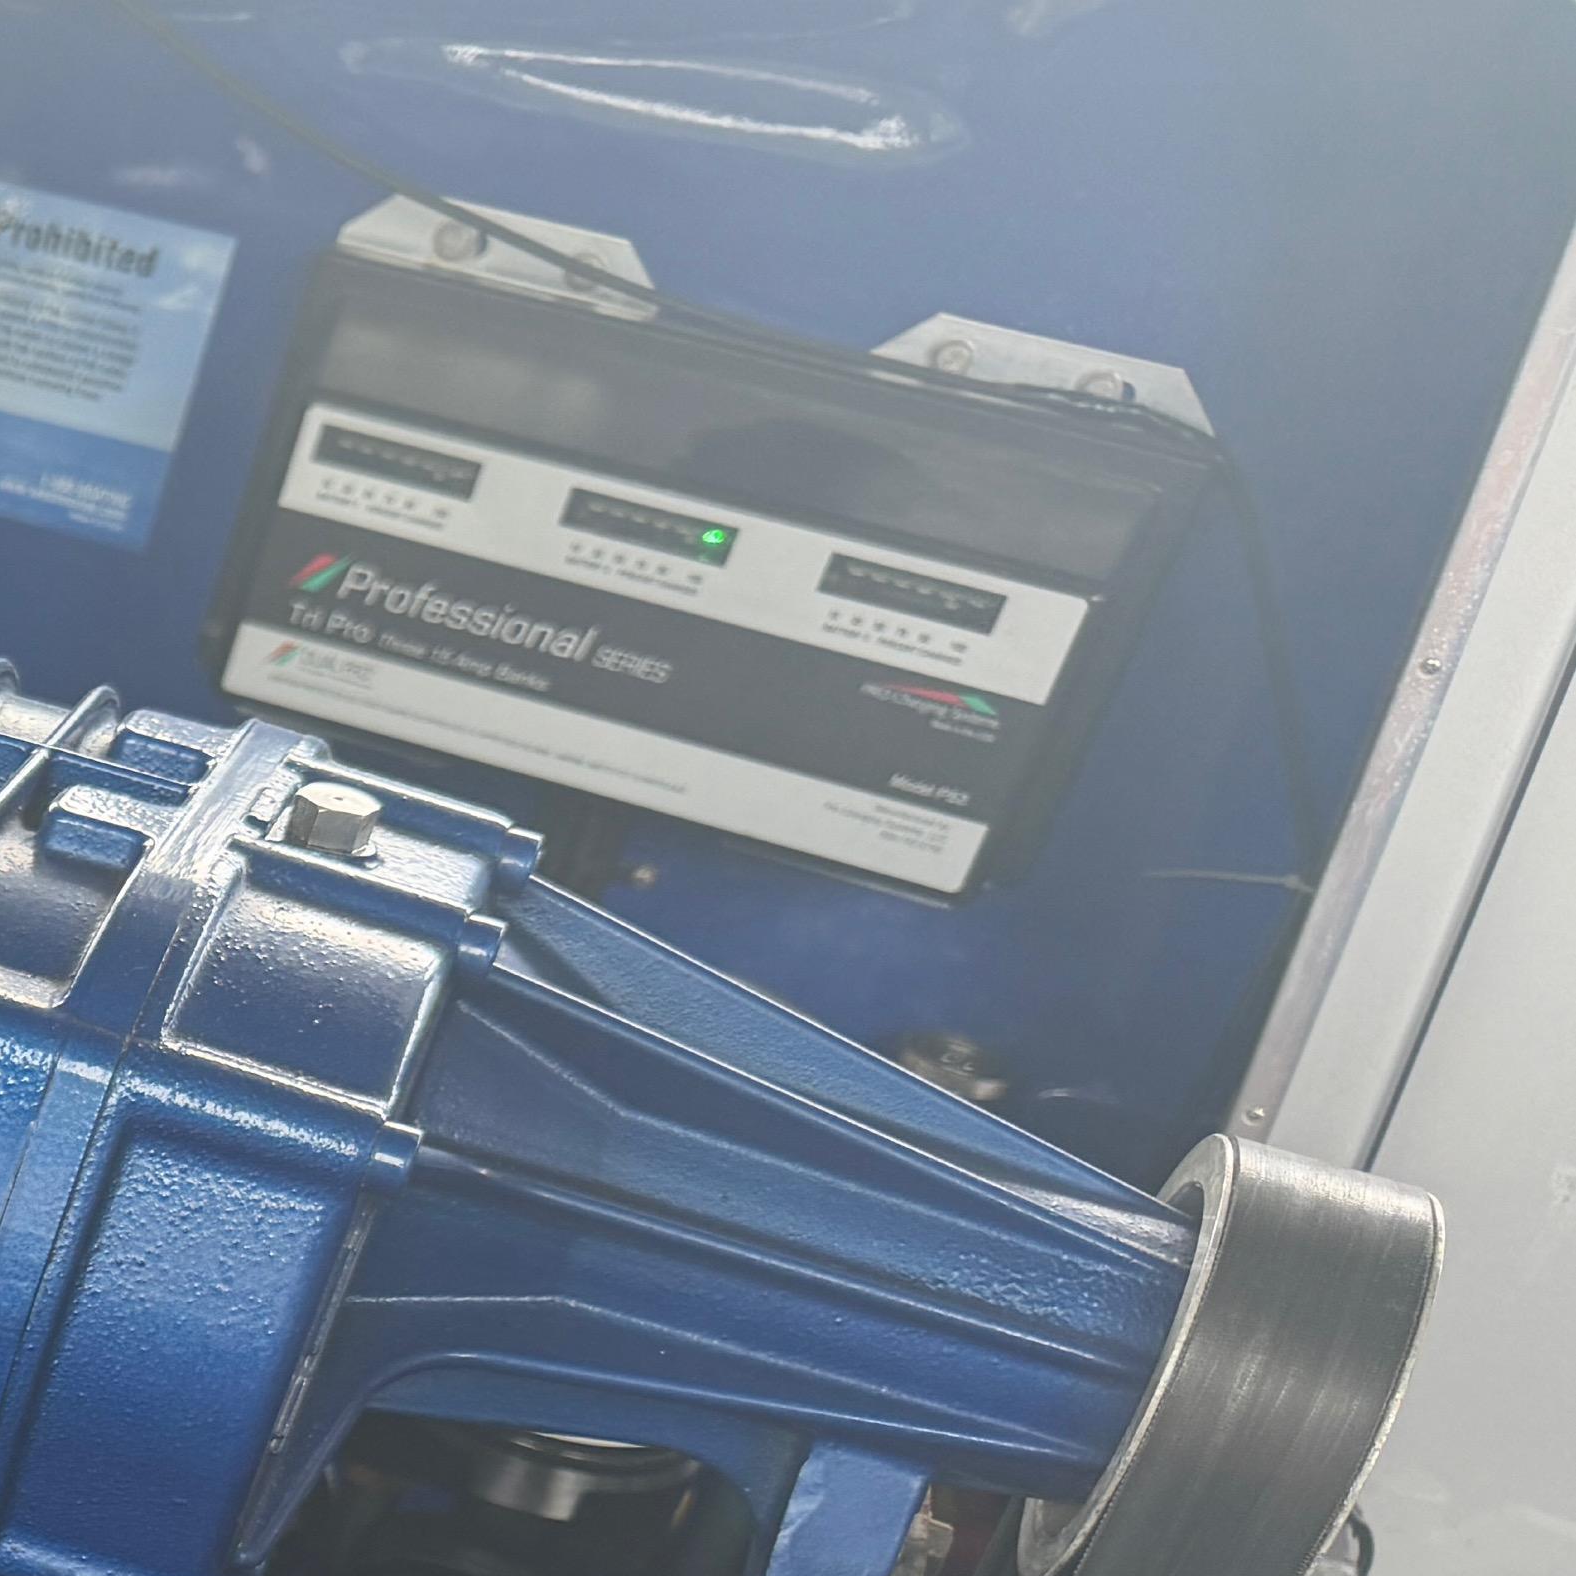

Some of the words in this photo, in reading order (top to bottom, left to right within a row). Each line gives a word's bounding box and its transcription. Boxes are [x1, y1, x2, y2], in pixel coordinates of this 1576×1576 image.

[325, 610, 376, 643] Pro
[336, 563, 599, 662] Professional
[592, 645, 673, 684] SERIES
